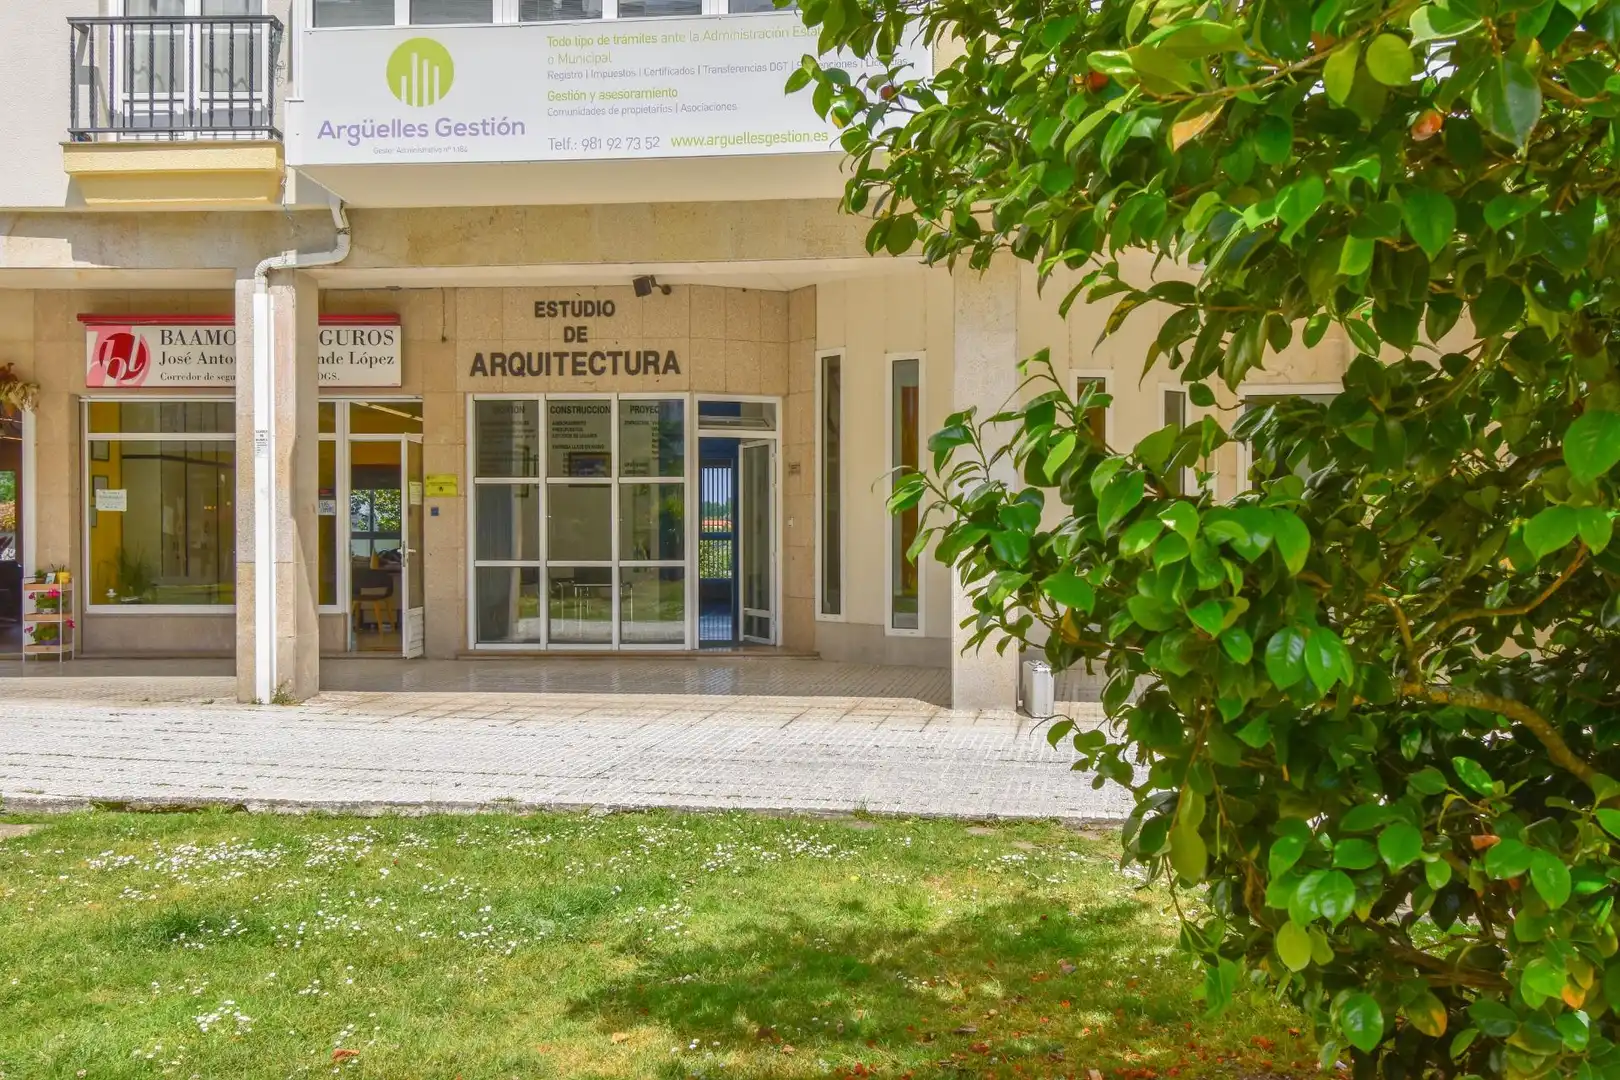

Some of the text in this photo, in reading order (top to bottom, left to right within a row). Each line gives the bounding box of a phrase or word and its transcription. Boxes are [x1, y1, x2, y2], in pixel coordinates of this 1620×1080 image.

[547, 36, 571, 47] Todo
[574, 34, 594, 49] tipo
[597, 34, 610, 46] de
[613, 33, 658, 45] trámites
[661, 32, 686, 43] ante
[689, 30, 700, 42] la
[703, 26, 789, 40] Administración
[547, 51, 612, 65] o Municipal
[547, 70, 583, 81] Registro
[591, 68, 636, 80] Impuestos
[643, 66, 695, 77] Certificados
[703, 62, 768, 75] Transferencias
[769, 61, 788, 72] DGT
[547, 87, 678, 103] Gestión y asesoramiento
[547, 102, 738, 117] Comunidades de propietarios Asociaciones
[317, 116, 526, 147] Argüelles Gestión
[548, 130, 829, 152] Telf.: 981 92 73 52 www.arguellesgestion.es
[534, 300, 616, 318] ESTUDIO
[160, 329, 394, 346] BAAMO GUROS
[563, 326, 588, 343] DE
[159, 351, 395, 368] José Anto nde López
[469, 350, 681, 377] ARQUITECTURA
[160, 372, 202, 381] Corredor
[203, 371, 215, 381] de
[217, 373, 236, 382] segu
[550, 405, 611, 414] CONSTRUCCION
[629, 405, 659, 414] PROYEC
